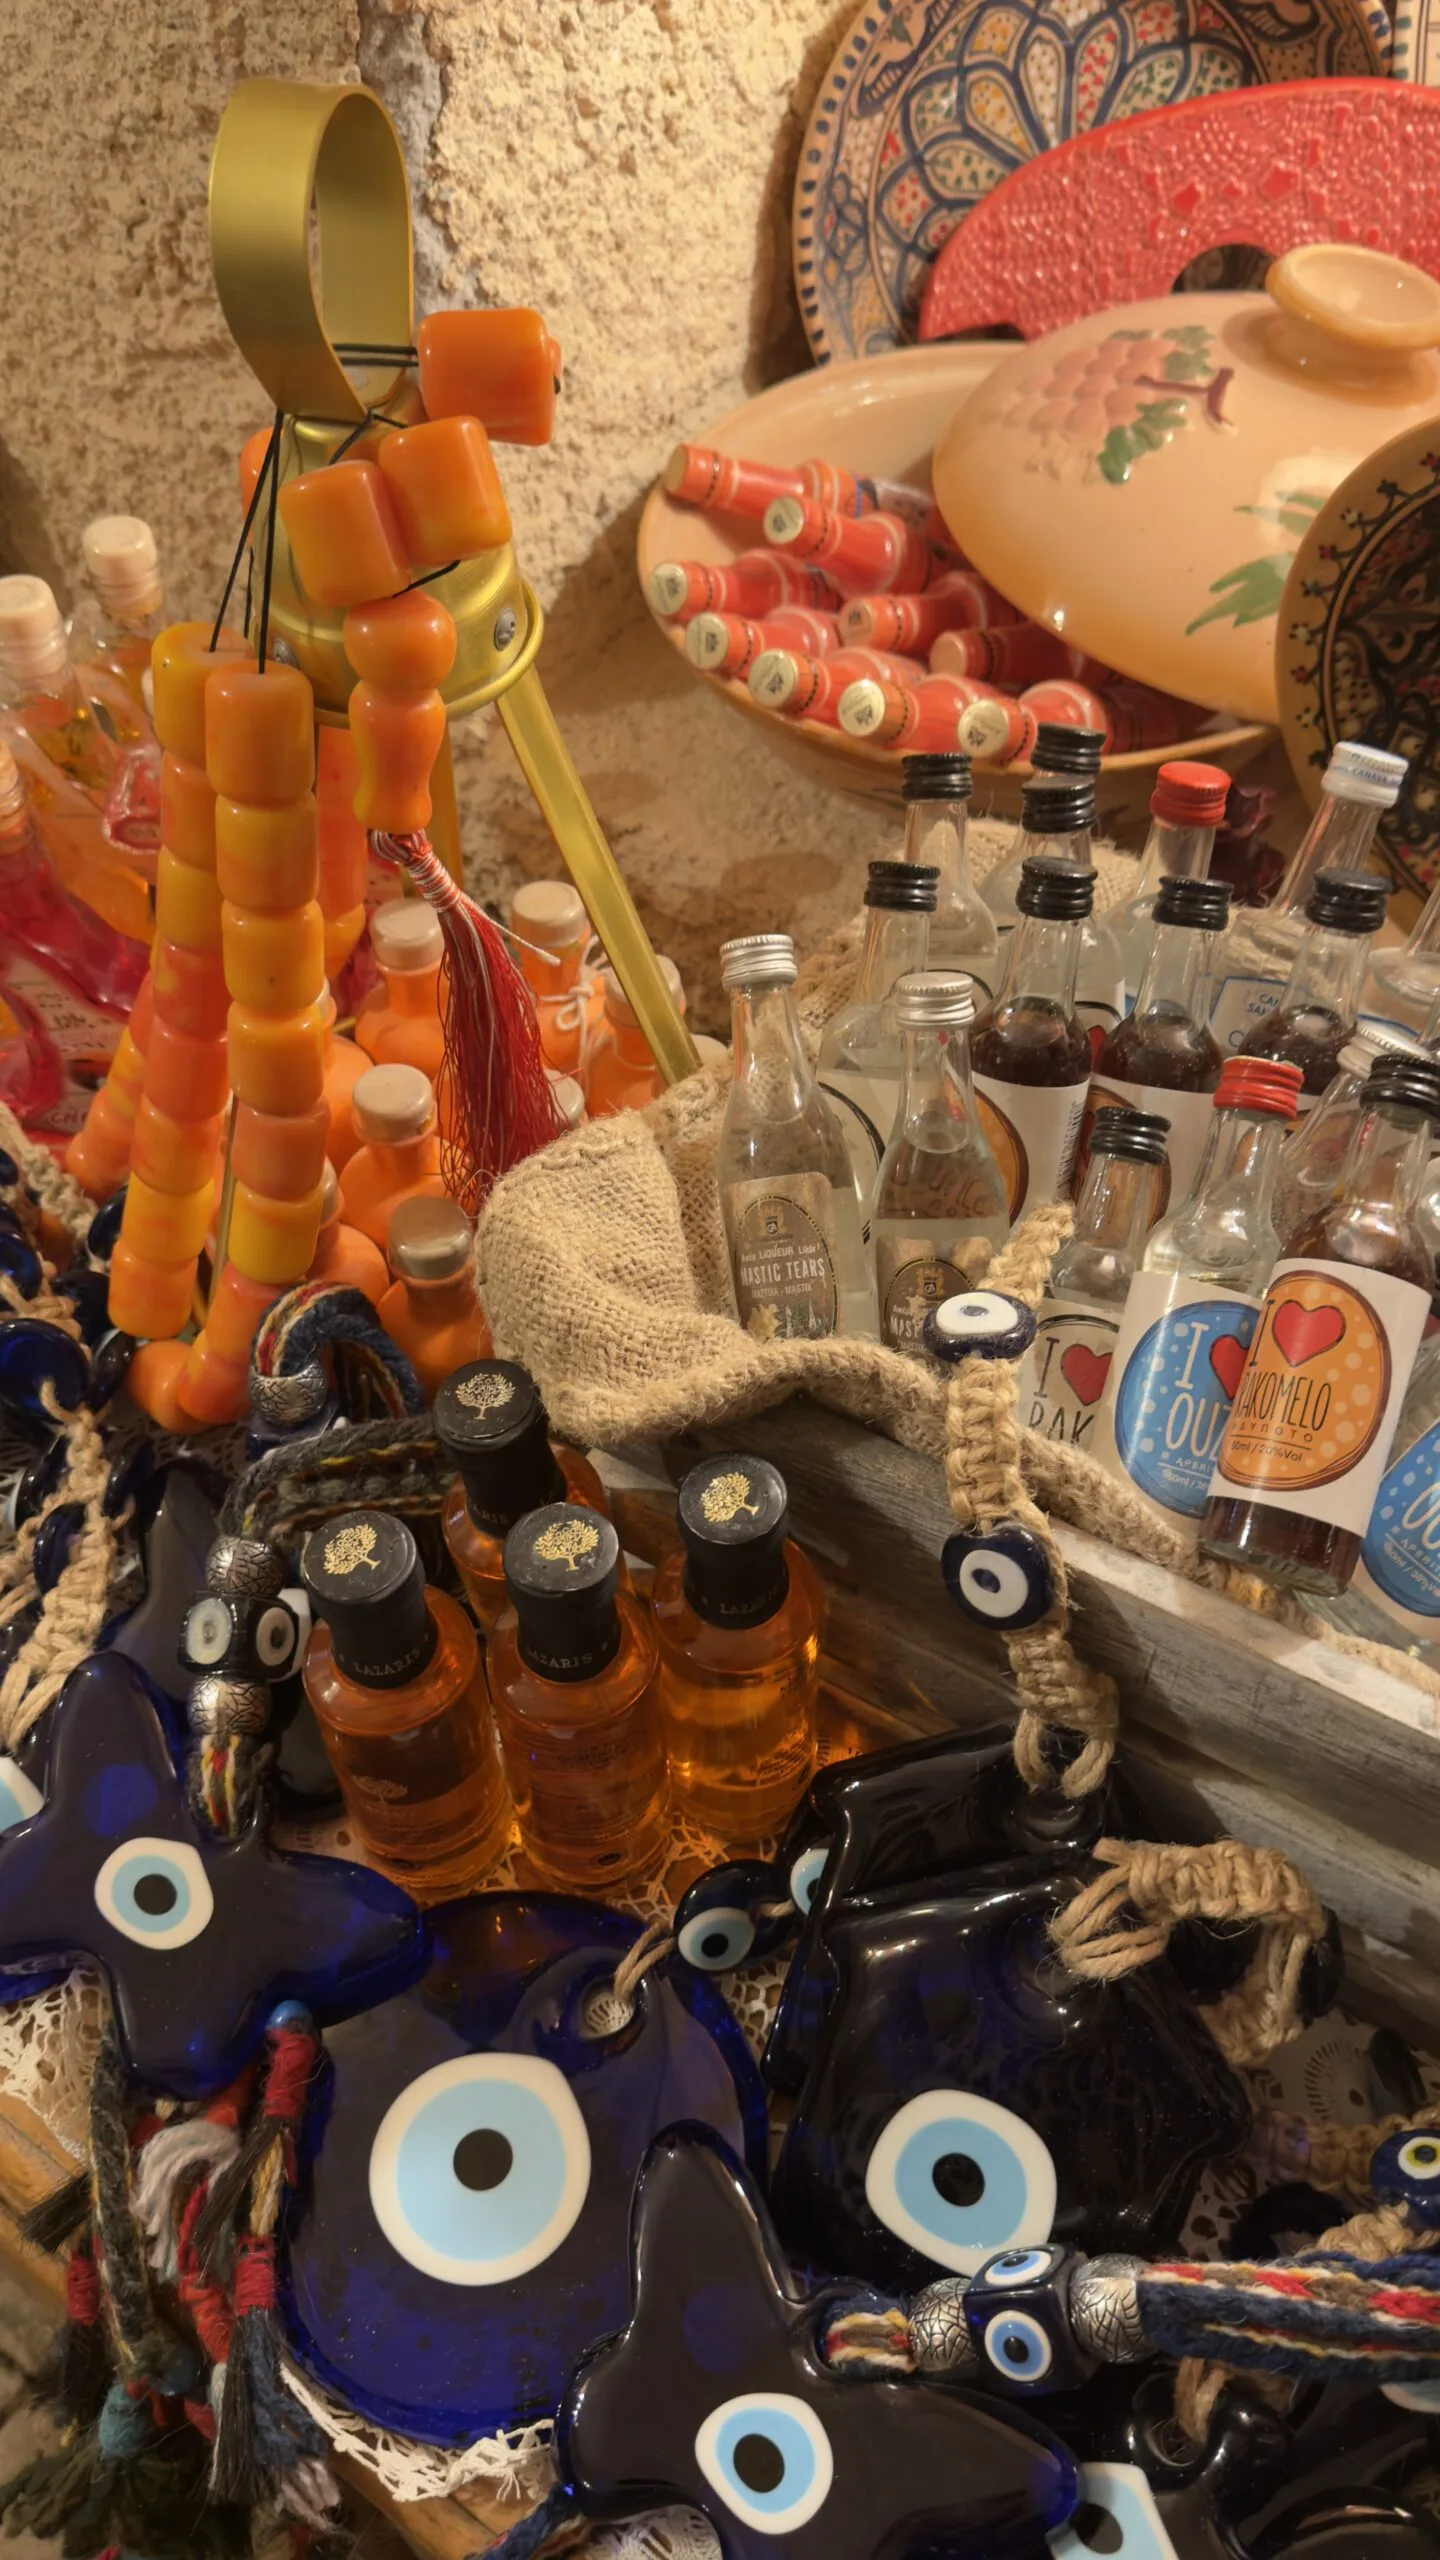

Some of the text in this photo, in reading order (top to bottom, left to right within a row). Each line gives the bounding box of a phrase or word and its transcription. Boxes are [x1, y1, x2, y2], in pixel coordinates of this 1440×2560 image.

[740, 1257, 826, 1286] MASTIC TEARS
[1235, 1371, 1332, 1432] RAKOMELO
[353, 1647, 419, 1677] LAZARIS
